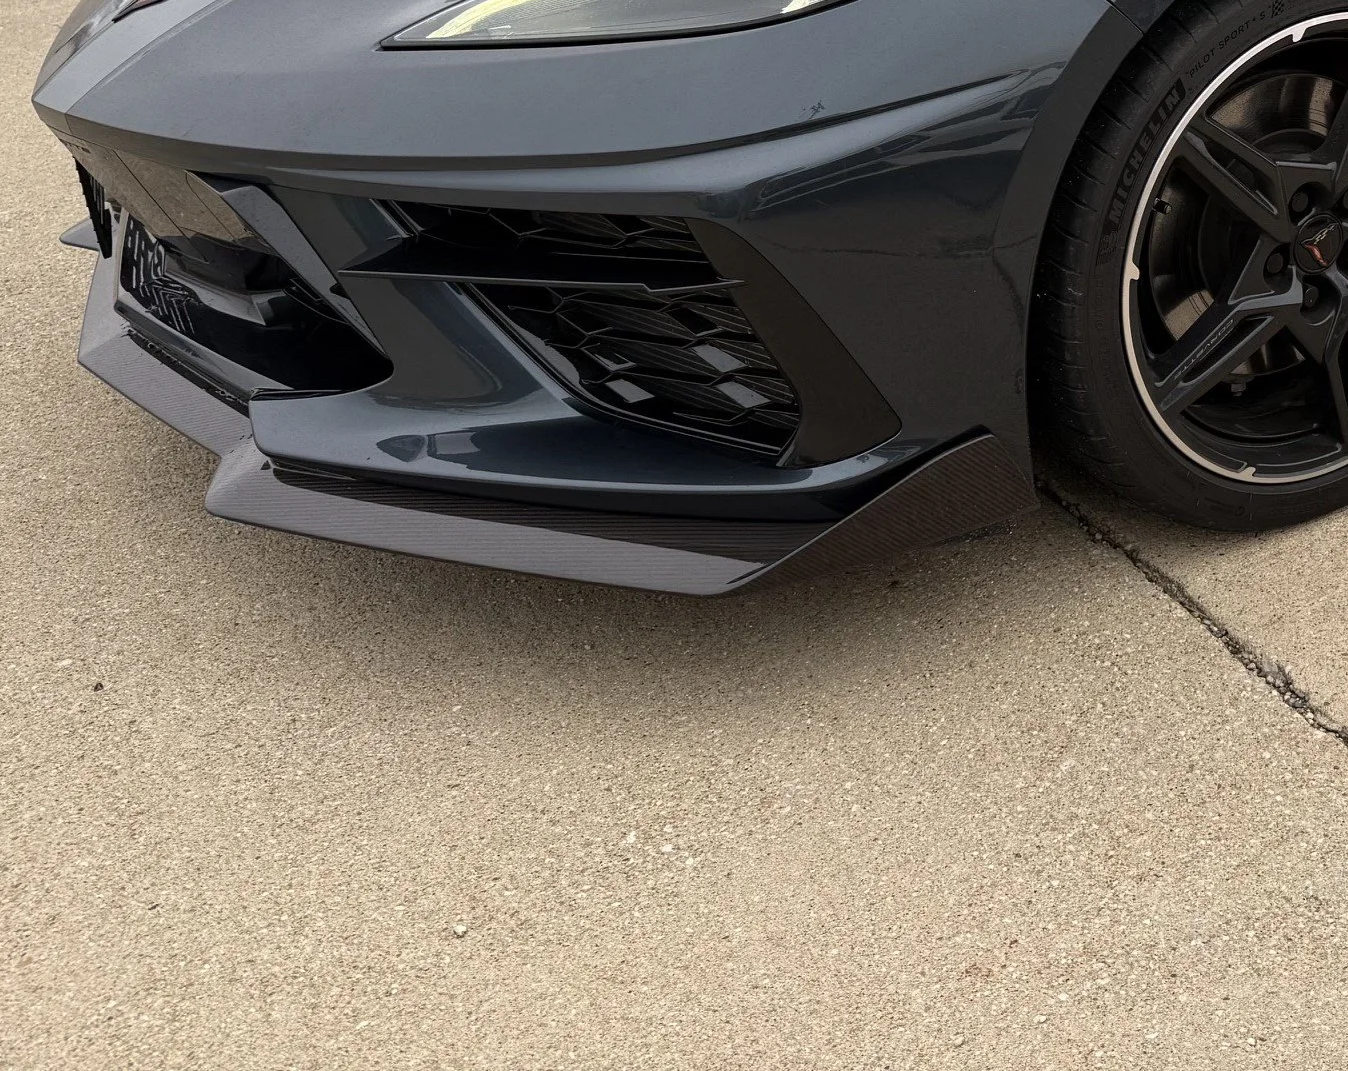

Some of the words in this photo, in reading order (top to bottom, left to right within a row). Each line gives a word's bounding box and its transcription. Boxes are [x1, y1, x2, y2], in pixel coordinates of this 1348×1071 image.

[1189, 47, 1217, 78] PILOT
[1218, 21, 1251, 50] SPORT
[1108, 83, 1182, 228] MICHELIN
